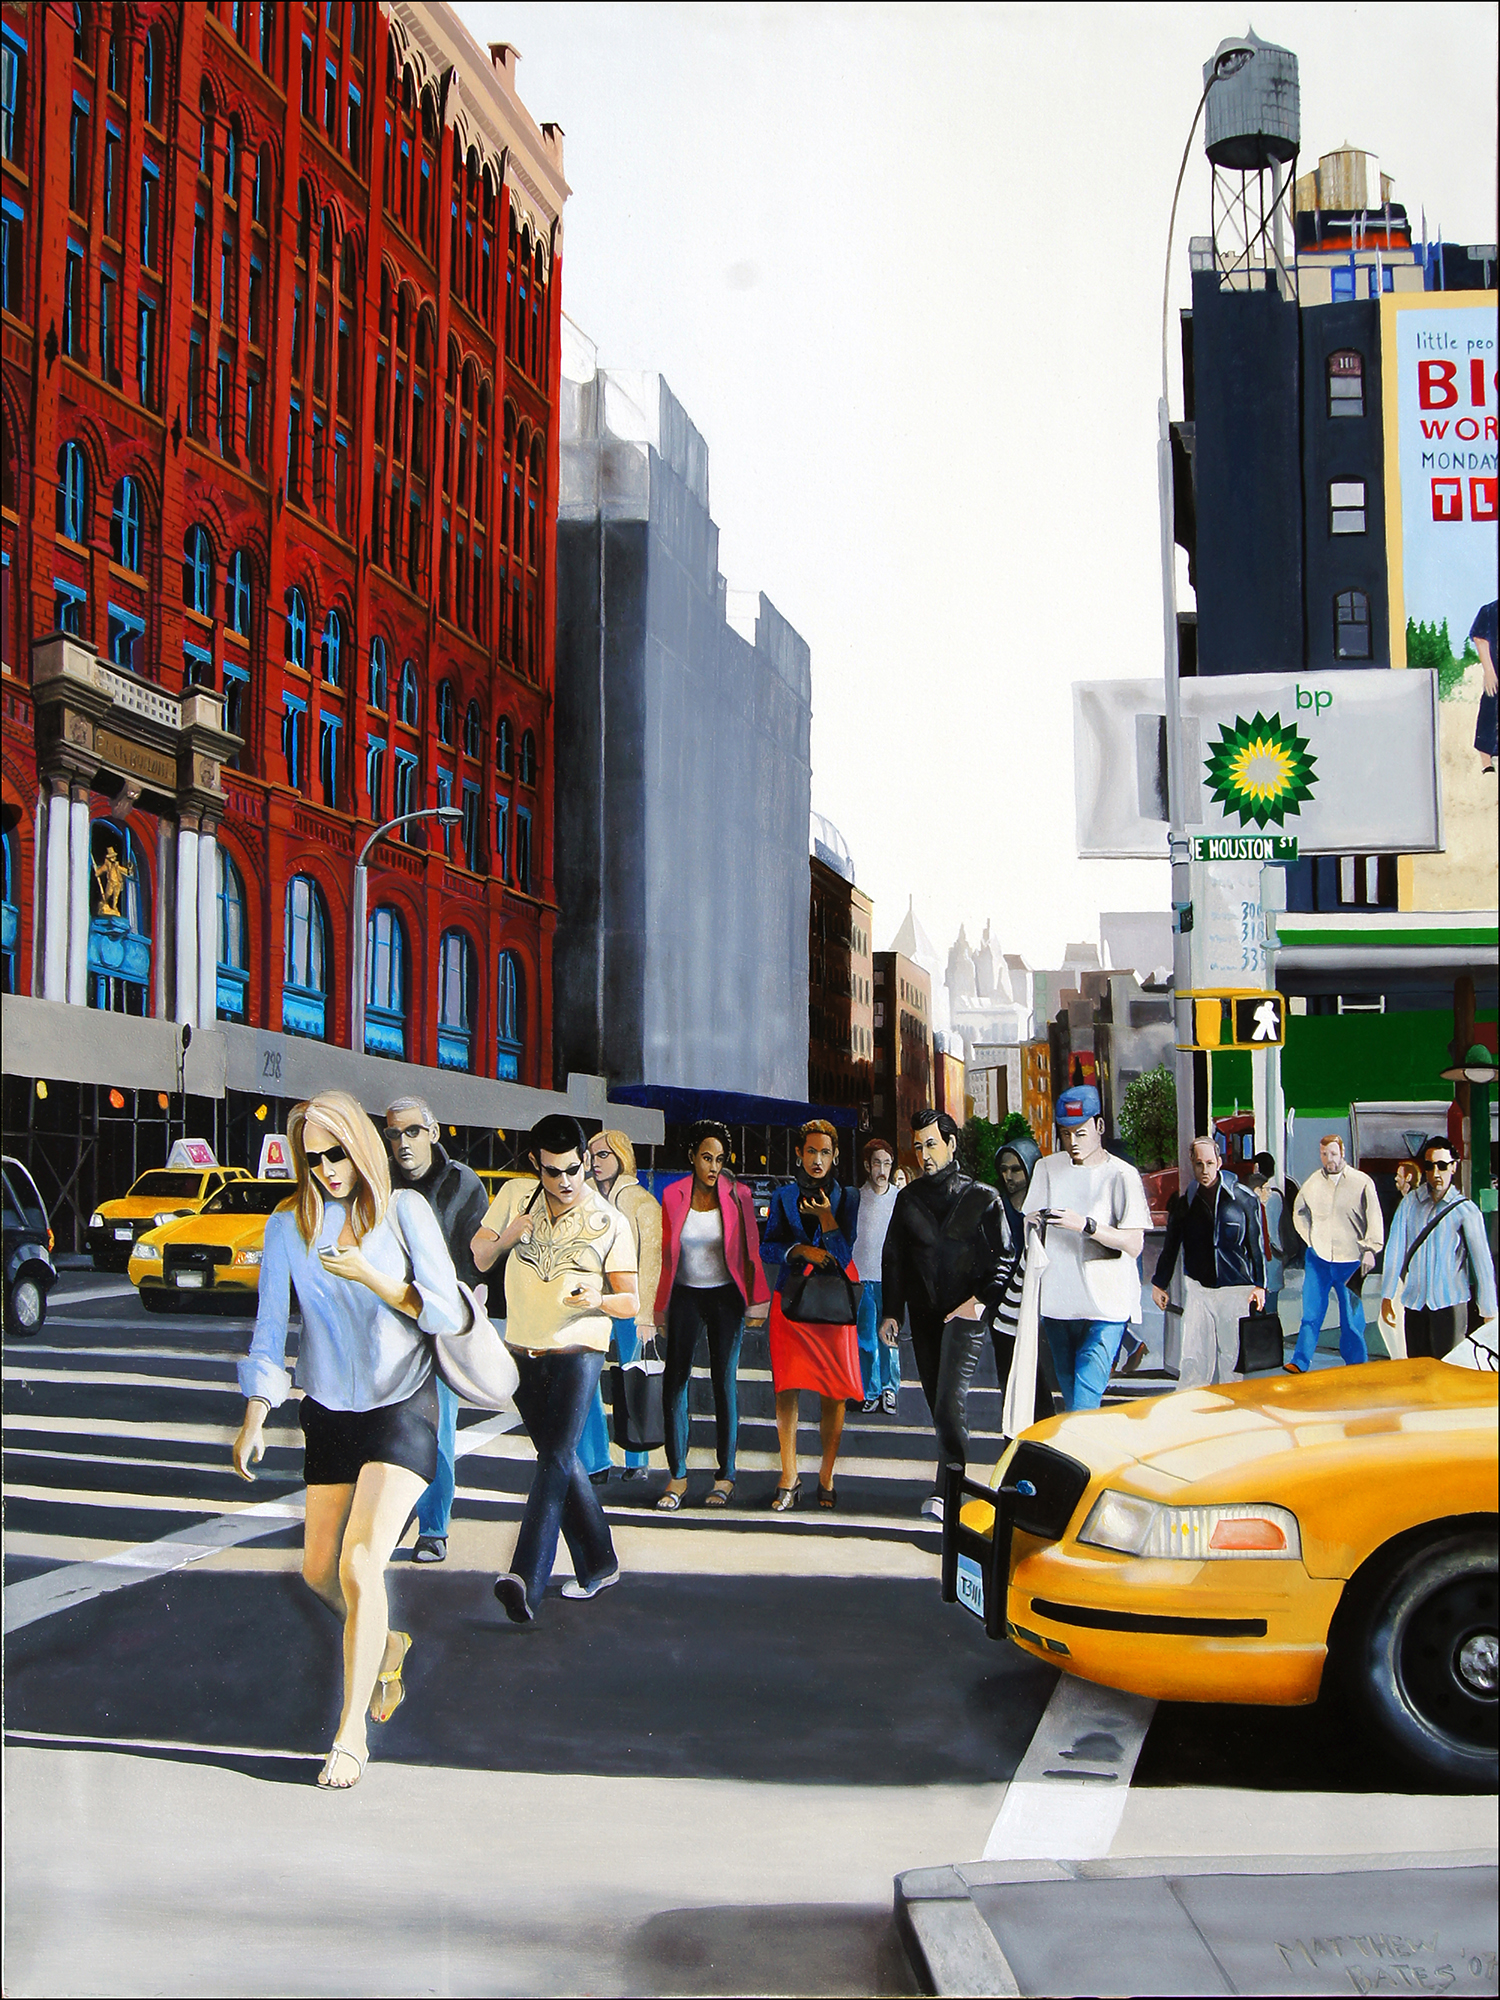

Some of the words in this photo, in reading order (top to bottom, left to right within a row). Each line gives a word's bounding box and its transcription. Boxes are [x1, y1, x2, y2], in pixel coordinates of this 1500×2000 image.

[1416, 331, 1458, 350] little
[1467, 339, 1494, 354] peo
[1418, 358, 1498, 410] BI
[1420, 415, 1498, 441] WOR
[1422, 452, 1498, 470] MONDAY
[1295, 684, 1333, 716] bp
[1195, 839, 1204, 860] E
[1209, 838, 1274, 859] HOUSTON
[1279, 836, 1294, 849] ST
[263, 1050, 282, 1079] 298
[1273, 1931, 1439, 1974] MATTHEW
[1345, 1963, 1456, 1996] BATES
